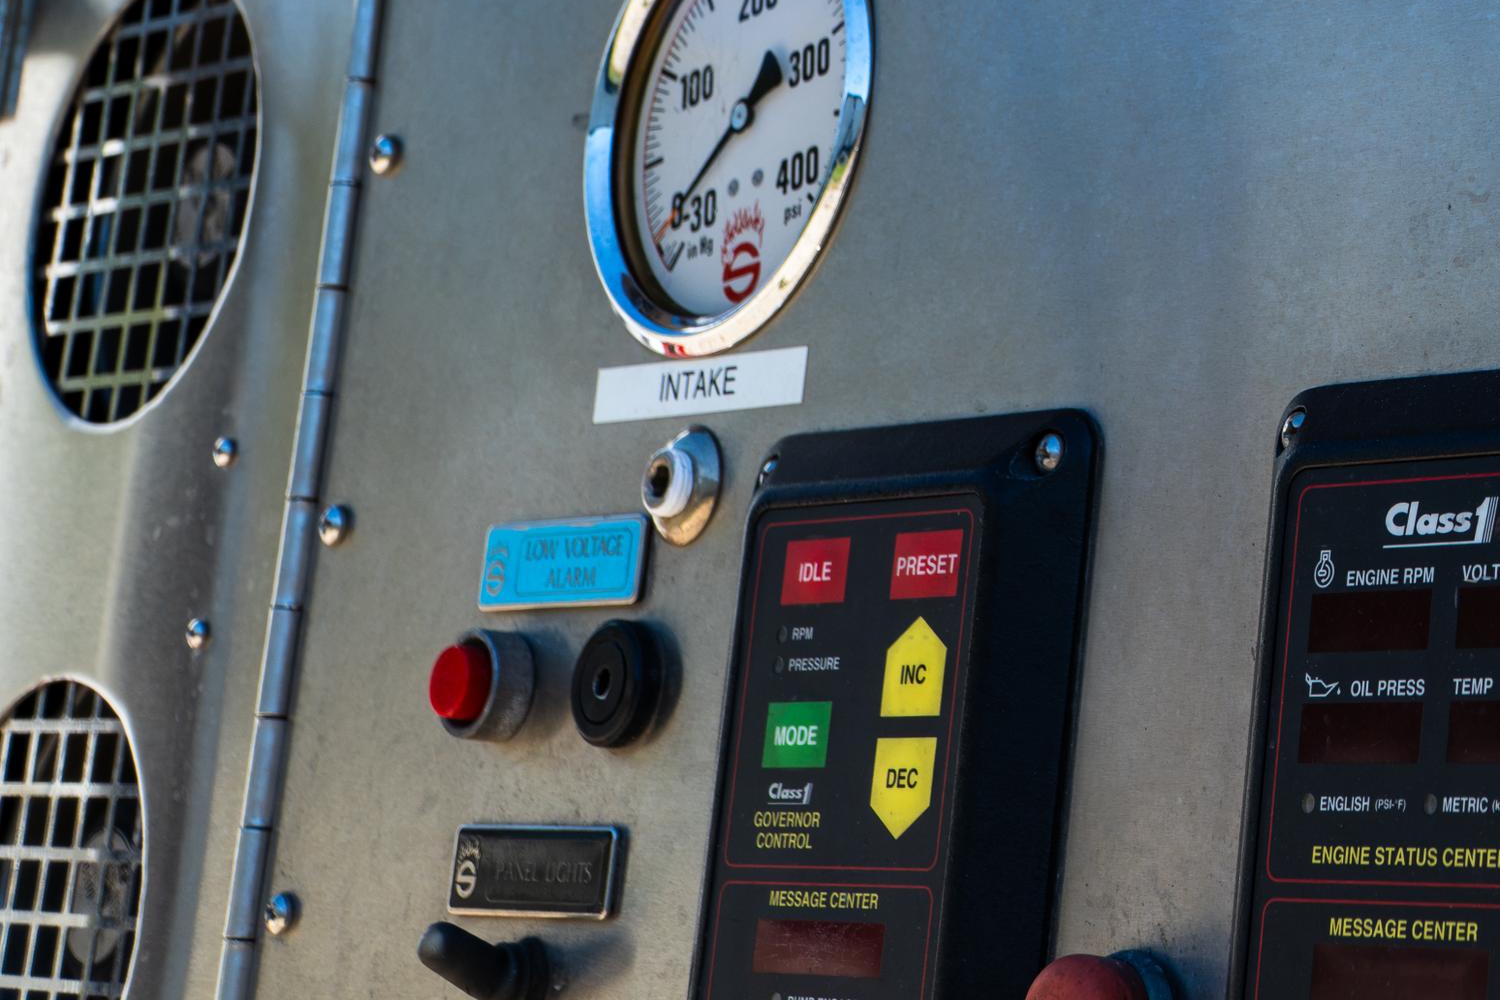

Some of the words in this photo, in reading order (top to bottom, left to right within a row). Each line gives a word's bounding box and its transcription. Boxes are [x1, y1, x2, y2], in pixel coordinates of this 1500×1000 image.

[789, 37, 830, 88] 300
[680, 65, 714, 110] 100
[776, 146, 819, 195] 400
[659, 366, 738, 402] INTAKE
[525, 538, 559, 562] LOW
[565, 534, 624, 558] VOLTAGE
[798, 561, 832, 583] IDLE
[896, 553, 958, 577] PRESET
[545, 568, 596, 589] ALARM
[1346, 568, 1399, 587] ENGINE
[1403, 566, 1435, 584] RPM
[792, 627, 814, 641] RPM
[788, 657, 840, 672] PRESSURE
[900, 664, 927, 685] INC
[1350, 680, 1373, 697] OIL
[1377, 679, 1426, 697] PRESS
[1453, 677, 1494, 696] TEMP
[774, 725, 818, 746] MODE
[886, 768, 919, 789] DEC
[1320, 795, 1370, 812] ENGLISH
[1442, 796, 1489, 813] METRIC
[754, 811, 821, 828] GOVERNOR
[756, 833, 812, 849] CONTROL
[1311, 845, 1370, 865] ENGINE
[1374, 847, 1438, 866] STATUS
[496, 861, 539, 882] PANEL
[769, 890, 827, 908] MESSAGE
[830, 892, 879, 910] CENTER
[1329, 917, 1407, 939] MESSAGE
[1411, 920, 1479, 942] CENTER
